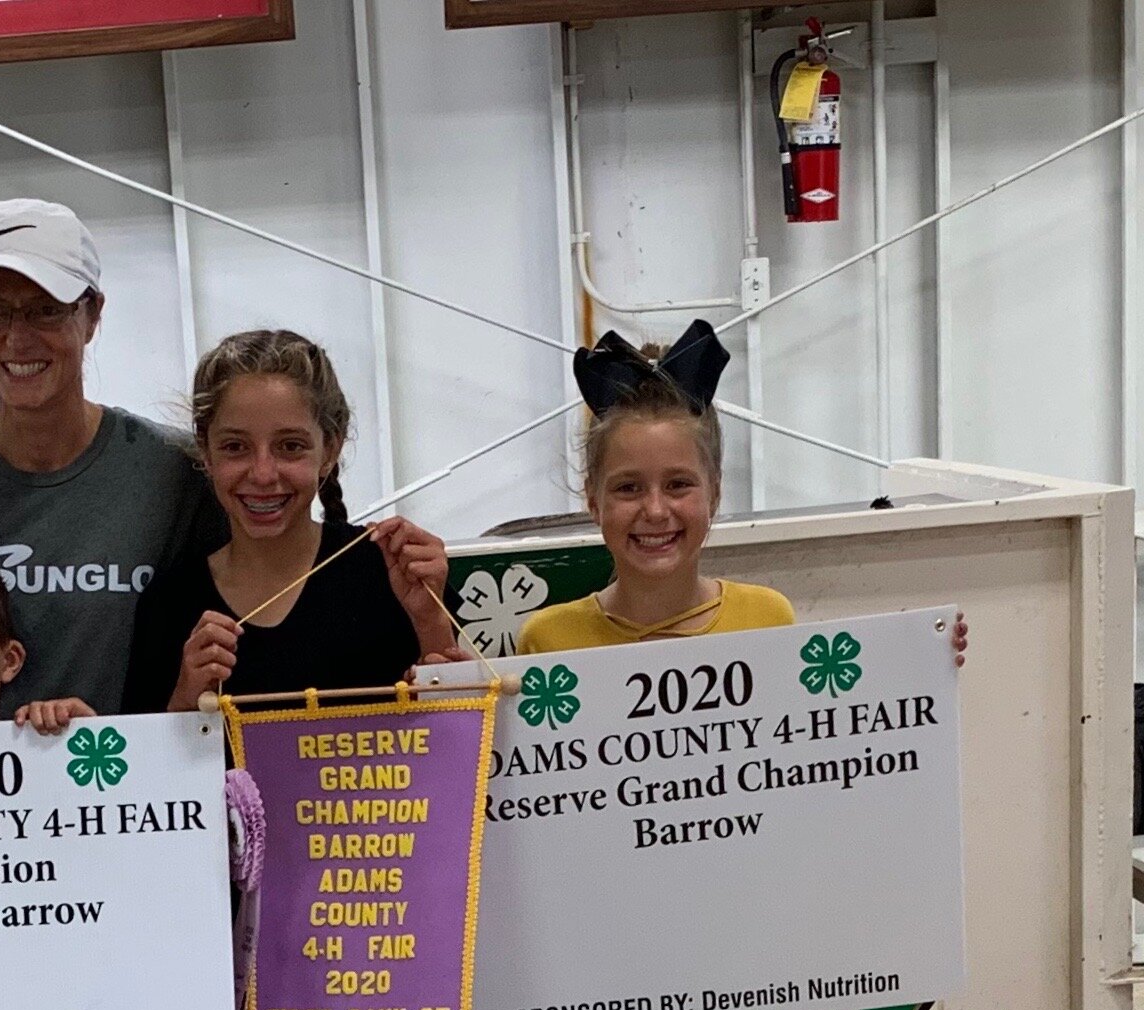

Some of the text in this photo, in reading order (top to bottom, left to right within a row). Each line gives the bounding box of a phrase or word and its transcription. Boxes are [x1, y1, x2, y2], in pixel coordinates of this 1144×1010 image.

[625, 661, 753, 719] 2020
[298, 728, 430, 759] RESERVE
[597, 717, 763, 765] COUNTY
[773, 708, 838, 744] 4-H
[848, 695, 938, 736] FAIR
[319, 764, 411, 791] GRAND
[617, 764, 727, 807] Grand
[737, 747, 919, 792] Champion
[43, 805, 106, 838] 4-H
[117, 800, 206, 834] FAIR
[296, 798, 429, 824] CHAMPION
[633, 813, 764, 849] Barrow
[308, 833, 415, 860] BARROW
[318, 867, 403, 893] ADAMS
[309, 901, 408, 926] COUNTY
[302, 934, 416, 961] 4-H FAIR
[325, 970, 391, 995] 2020
[808, 973, 900, 1001] Nutrition
